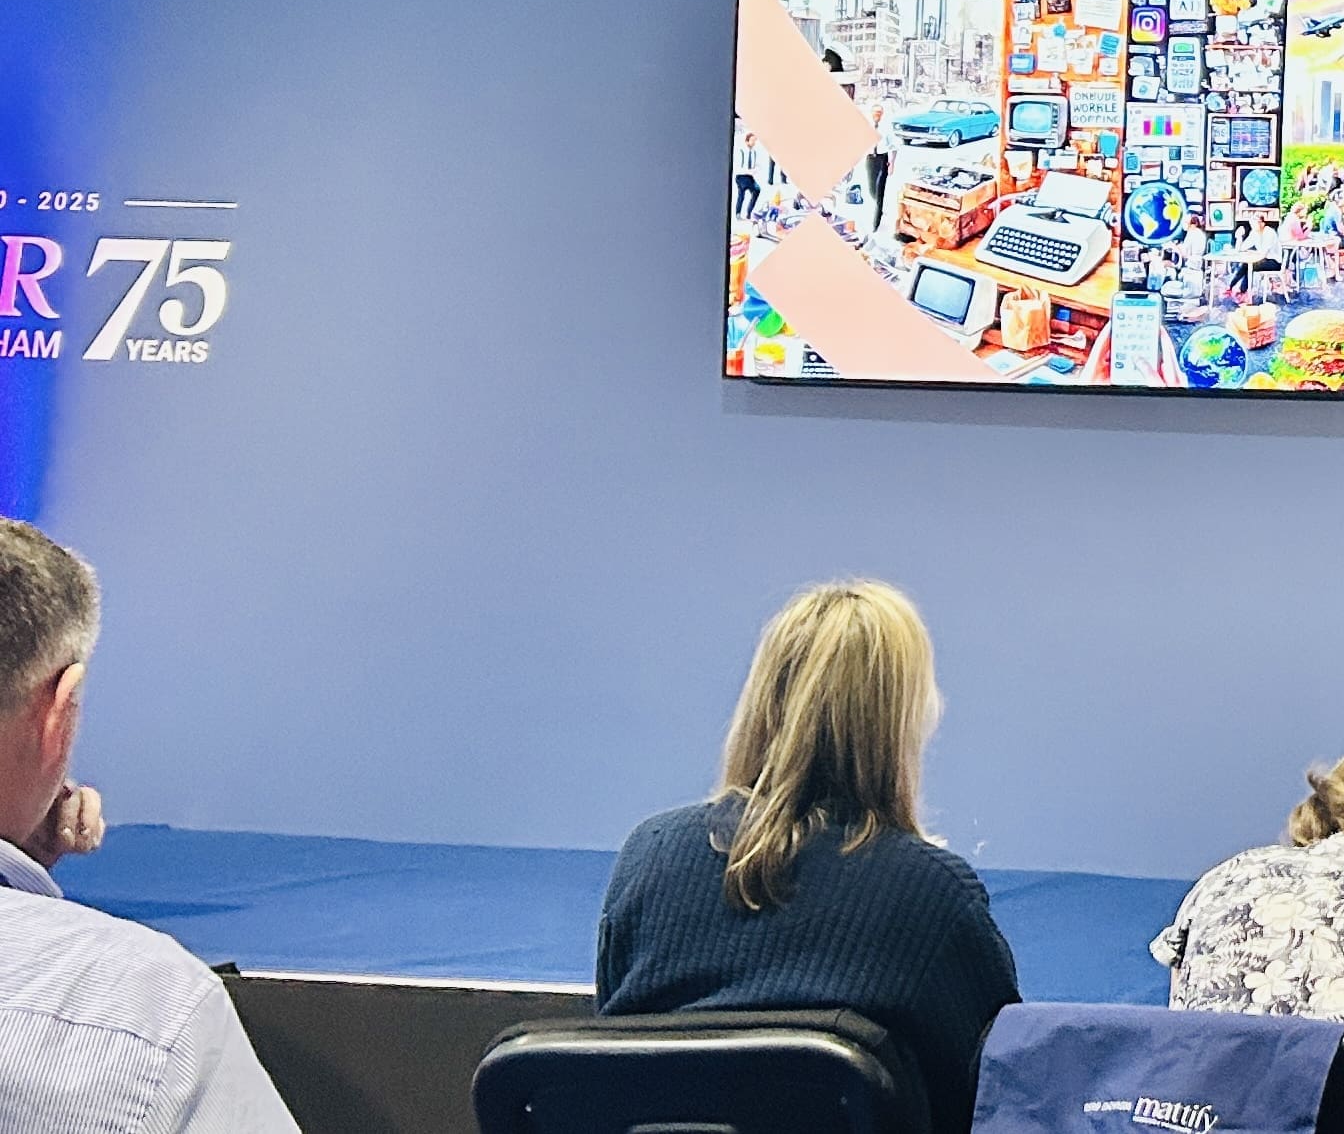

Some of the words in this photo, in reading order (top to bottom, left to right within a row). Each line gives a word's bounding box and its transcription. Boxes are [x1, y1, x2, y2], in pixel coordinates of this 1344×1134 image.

[37, 191, 100, 212] 2025
[82, 237, 232, 362] 75
[125, 338, 209, 364] YEARS
[1134, 1096, 1218, 1134] mattify
